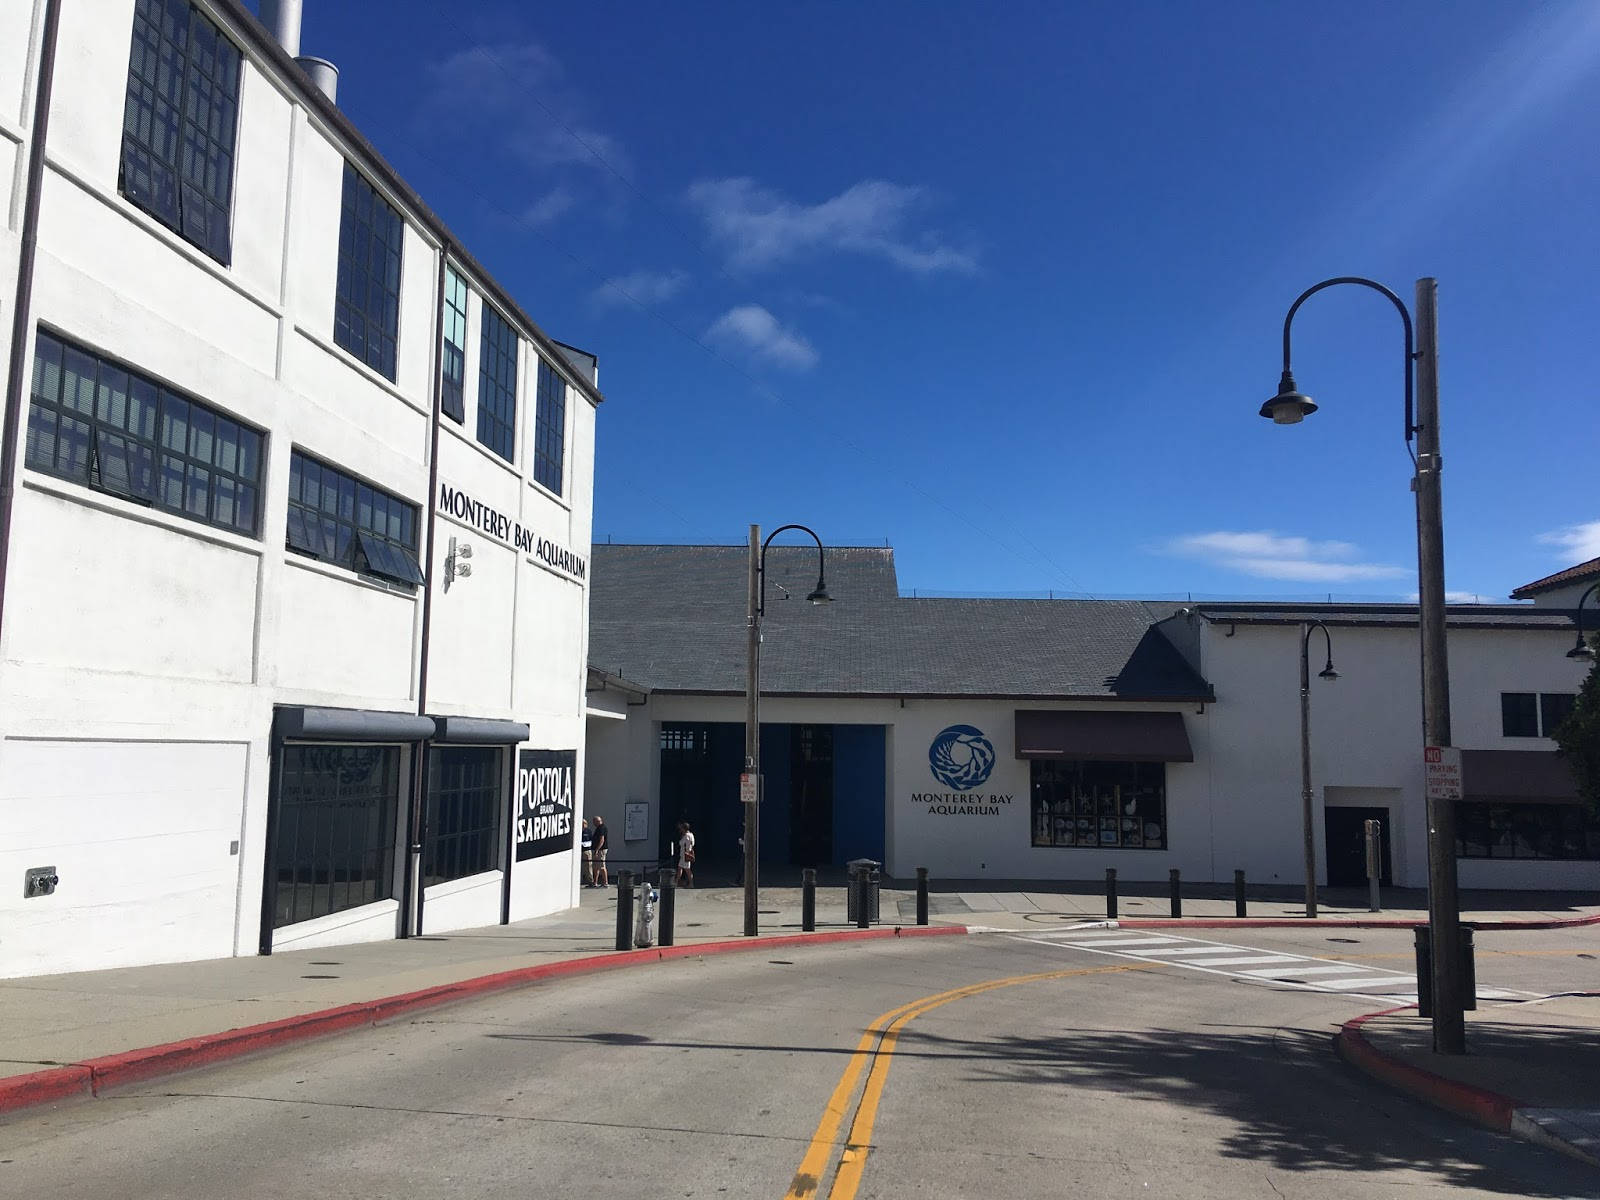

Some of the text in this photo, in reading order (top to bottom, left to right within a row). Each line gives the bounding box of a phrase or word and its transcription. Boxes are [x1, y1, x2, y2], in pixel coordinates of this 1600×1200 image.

[440, 484, 586, 580] MONTEREY BAY AQUARIUM
[518, 767, 572, 816] PORTOLA
[911, 793, 1013, 804] MONTEREY BAY
[540, 804, 555, 815] BRAND
[928, 805, 1000, 815] AQUARIUM
[517, 812, 571, 843] SARDINES
